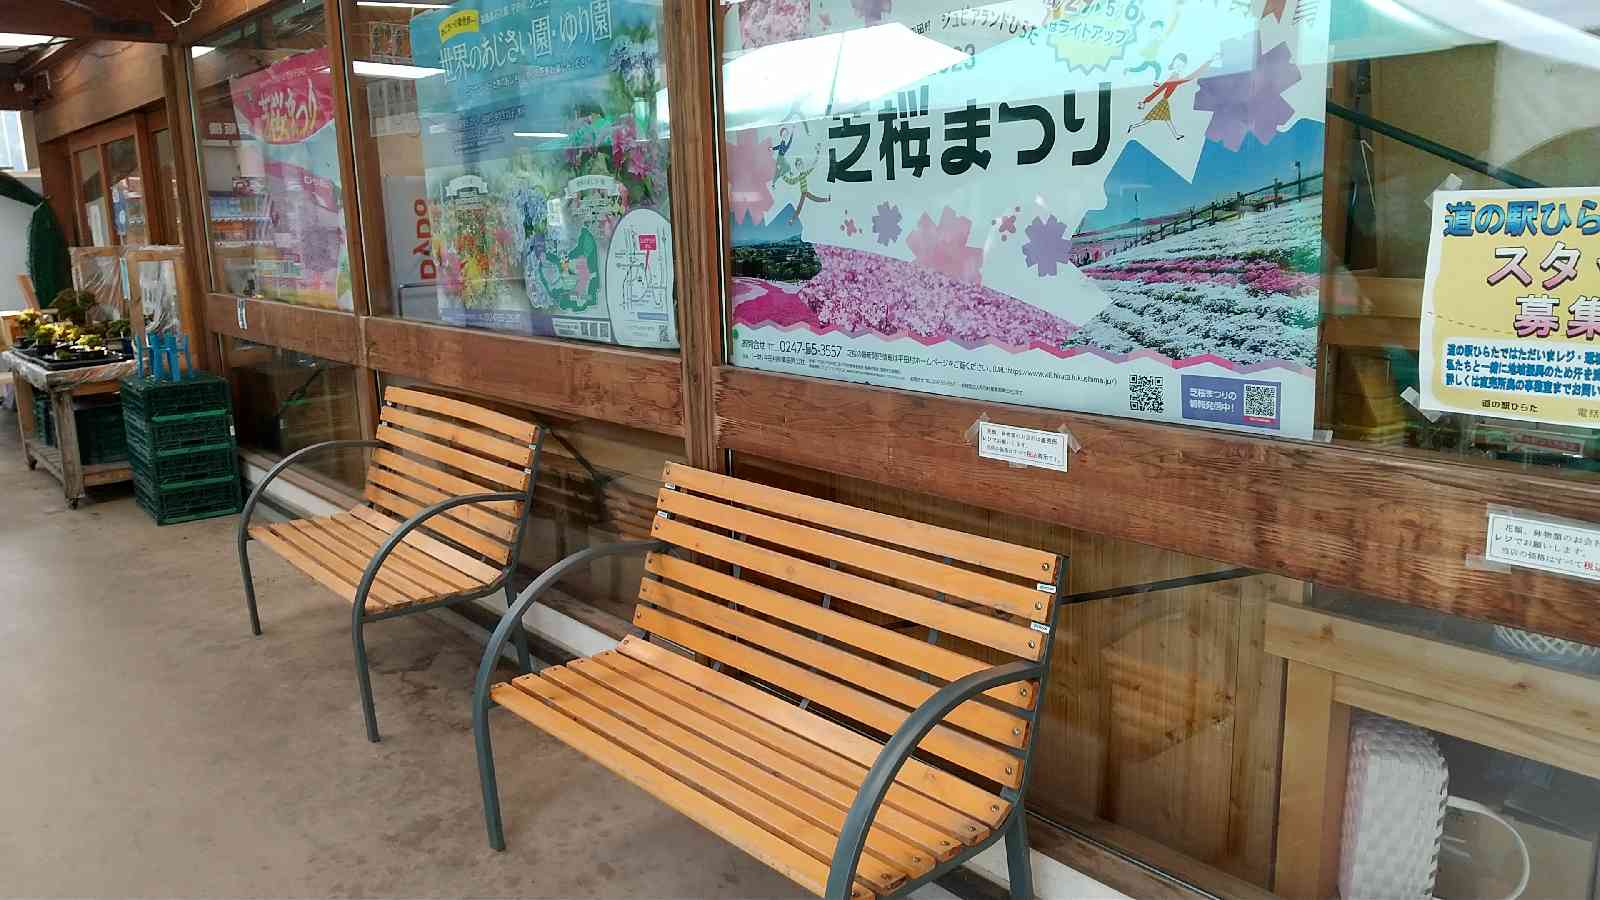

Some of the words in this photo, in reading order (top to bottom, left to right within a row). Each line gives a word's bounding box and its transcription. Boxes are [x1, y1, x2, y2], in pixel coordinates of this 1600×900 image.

[941, 5, 1040, 46] ジュピアランドひらた
[1048, 19, 1130, 44] はライトアップ
[827, 81, 1112, 183] 芝桜まつり
[1443, 200, 1600, 237] 道の駅ひら
[1487, 240, 1600, 290] スタ
[1513, 294, 1600, 341] 募集
[1189, 387, 1237, 401] 芝桜まつりの
[1481, 399, 1539, 413] 道の駅ひらた
[1495, 534, 1586, 557] レジでお願いします。
